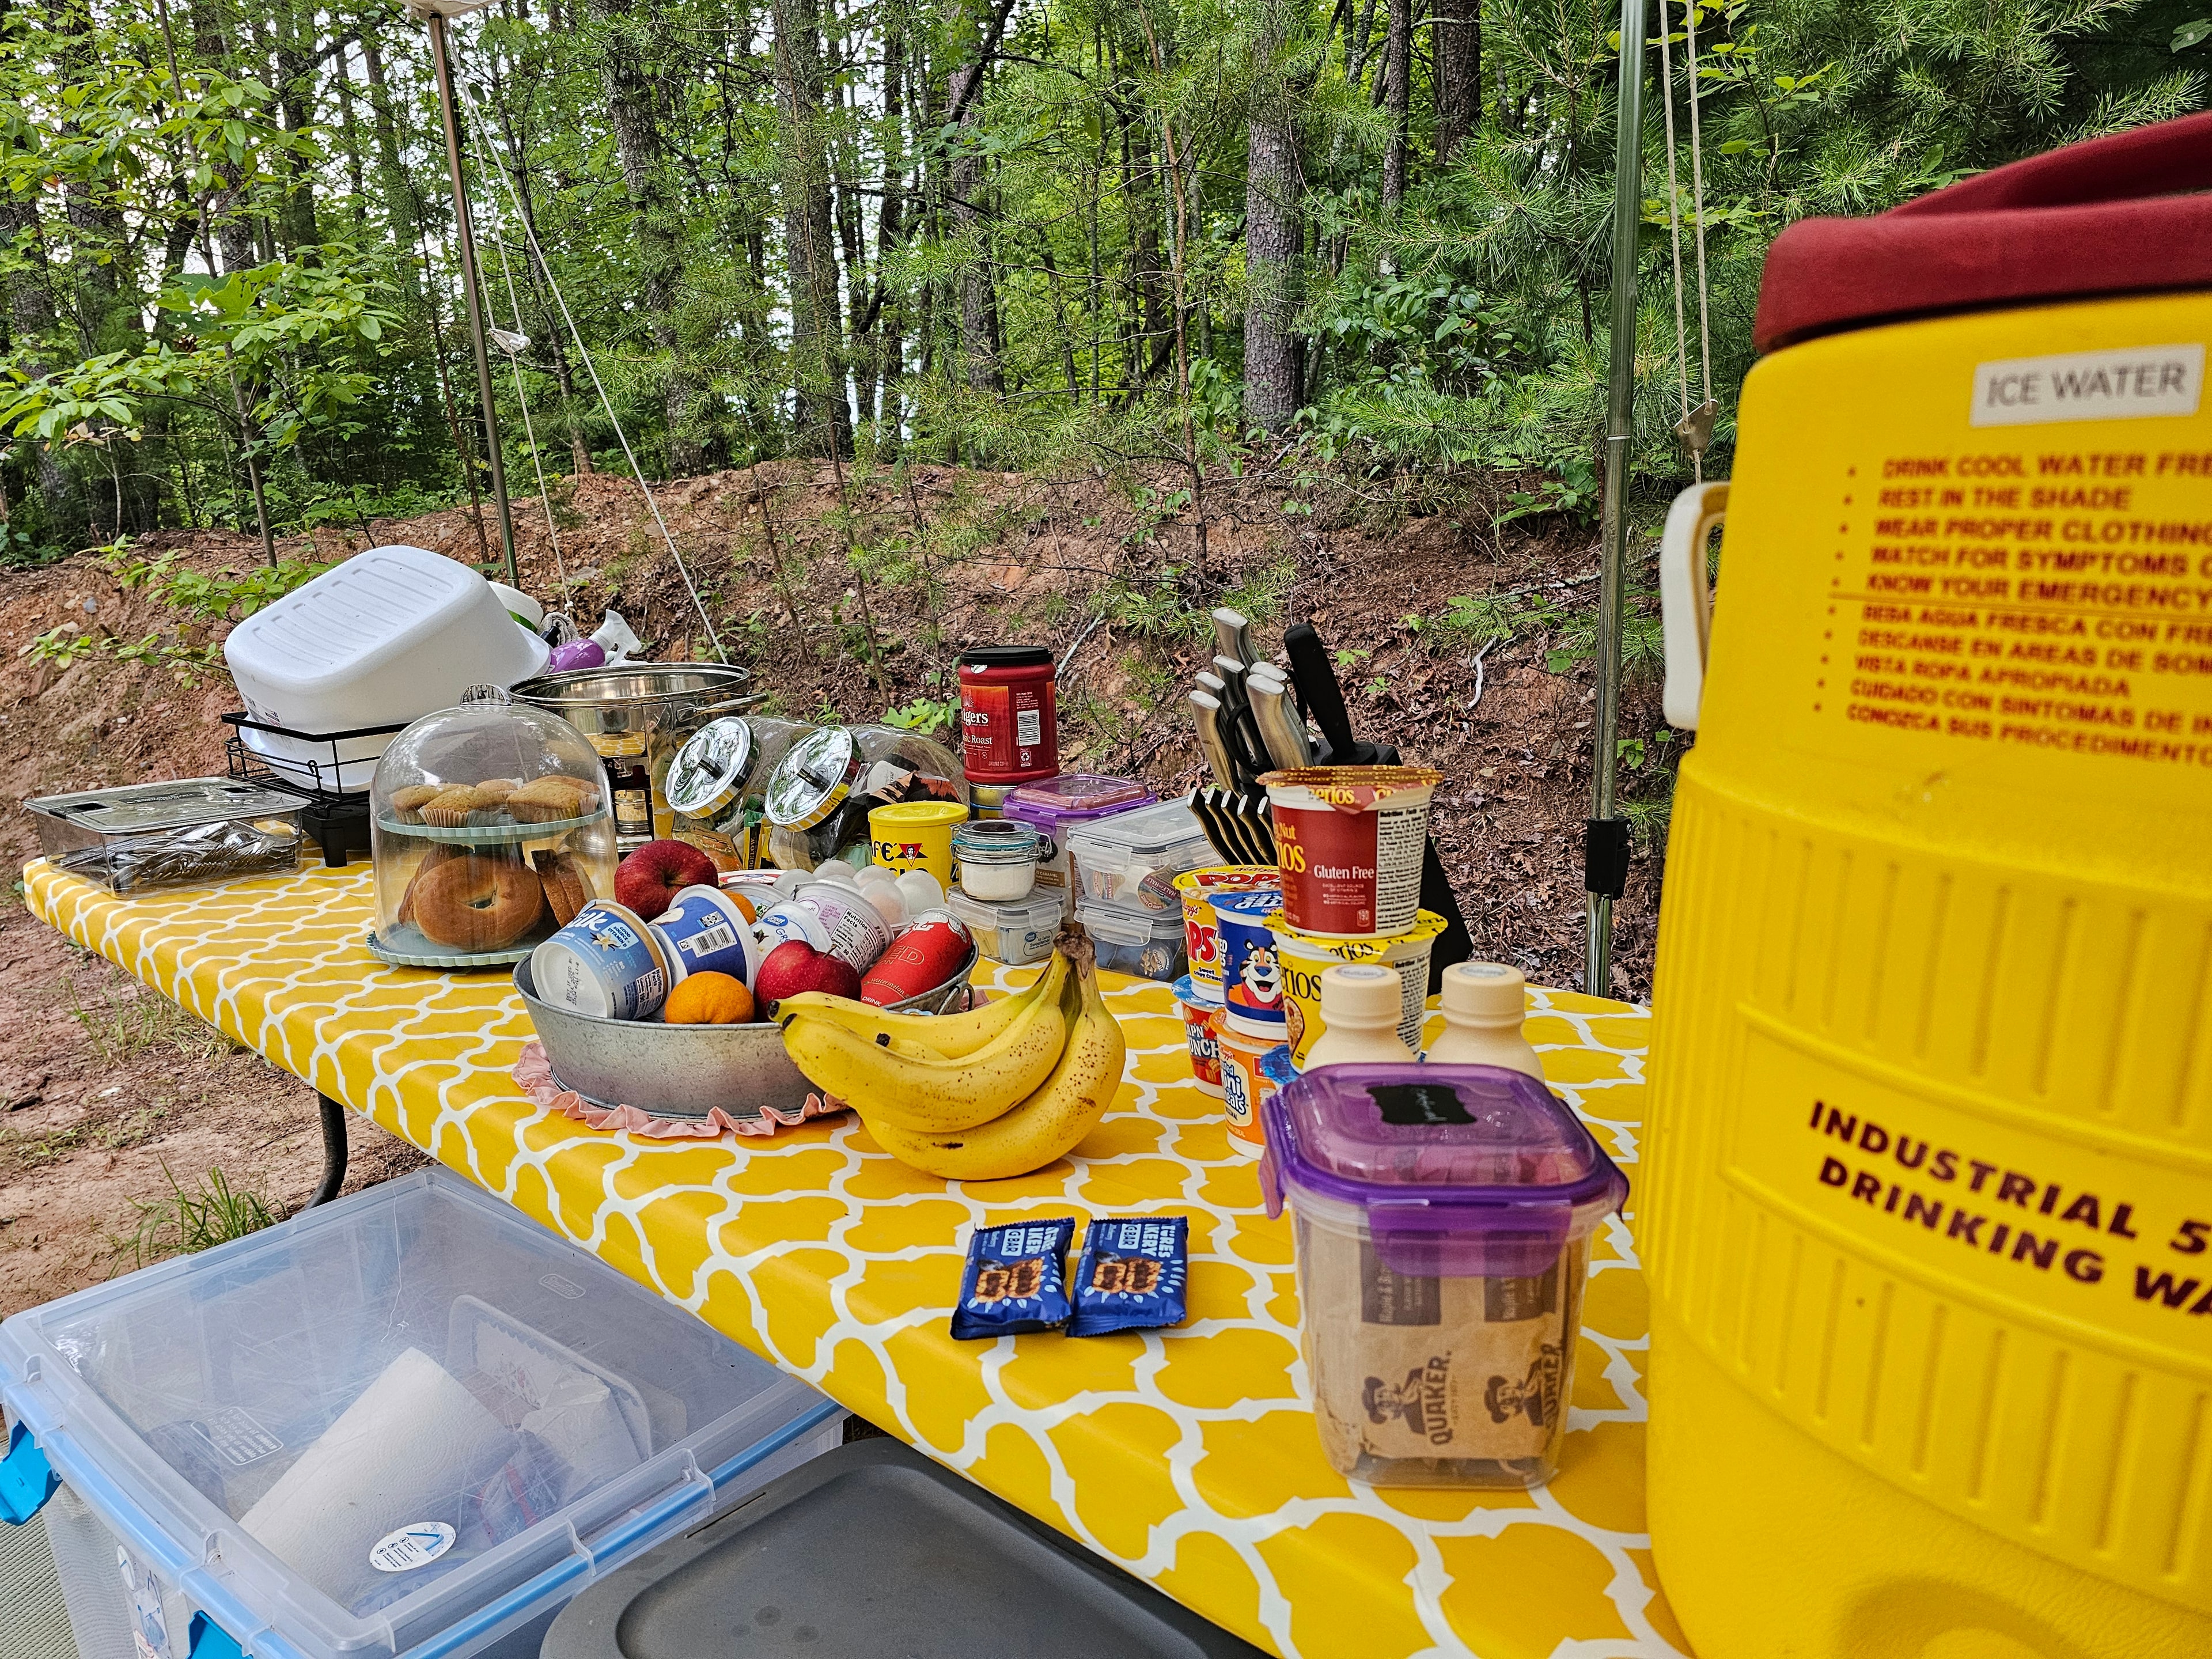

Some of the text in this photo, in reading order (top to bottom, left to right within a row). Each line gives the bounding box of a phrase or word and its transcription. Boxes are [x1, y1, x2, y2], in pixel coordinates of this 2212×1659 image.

[1986, 359, 2187, 408] ICE WATER
[1883, 457, 1949, 478] DRINK
[1957, 453, 2026, 478] COOL
[2037, 453, 2146, 478] WATER
[1878, 486, 2134, 512] REST IN THE SHADE
[1875, 517, 1938, 539] WEAR
[1945, 517, 2052, 542] PROPER
[1871, 546, 1950, 567] WATCH
[1955, 546, 2009, 569] FOR
[2017, 550, 2188, 578] SYMPTOMS
[1867, 574, 1932, 594] KNOW
[1942, 575, 2010, 599] YOUR
[1862, 604, 1912, 623] BEBA
[1919, 608, 1978, 628] AGUA
[1987, 612, 2086, 637] FRESCA
[2095, 618, 2157, 641] CON
[1857, 628, 1963, 656] DESCANSE
[1970, 638, 2003, 659] EN
[2008, 642, 2097, 668] AREAS
[2105, 648, 2142, 673] DE
[1854, 656, 2130, 699] VISTA ROPA APROPIADA
[1850, 680, 1938, 707] CUIDADO
[1941, 689, 1993, 711] CON
[1999, 694, 2135, 729] SINTOMAS
[2143, 707, 2183, 733] DE
[1846, 703, 1941, 732] CONOZCA
[1947, 716, 1992, 741] SUS
[971, 734, 993, 745] Roast
[1146, 877, 1160, 887] HALF
[1196, 873, 1280, 887] POP
[1313, 865, 1375, 880] Gluten Free
[1162, 885, 1176, 897] HALF
[620, 926, 631, 938] GOOD
[843, 915, 858, 928] Facts
[846, 911, 868, 931] Nutrition
[608, 927, 624, 943] VITAMIN
[612, 926, 628, 942] SOURCE
[836, 929, 847, 938] Serving
[619, 961, 625, 969] NO
[1153, 949, 1164, 971] delight
[871, 978, 904, 994] Watermelon
[862, 996, 882, 1007] DRINK
[1809, 1101, 2138, 1241] INDUSTRIAL
[1819, 1156, 2105, 1285] DRINKING
[1425, 1355, 1452, 1445] QUAKER
